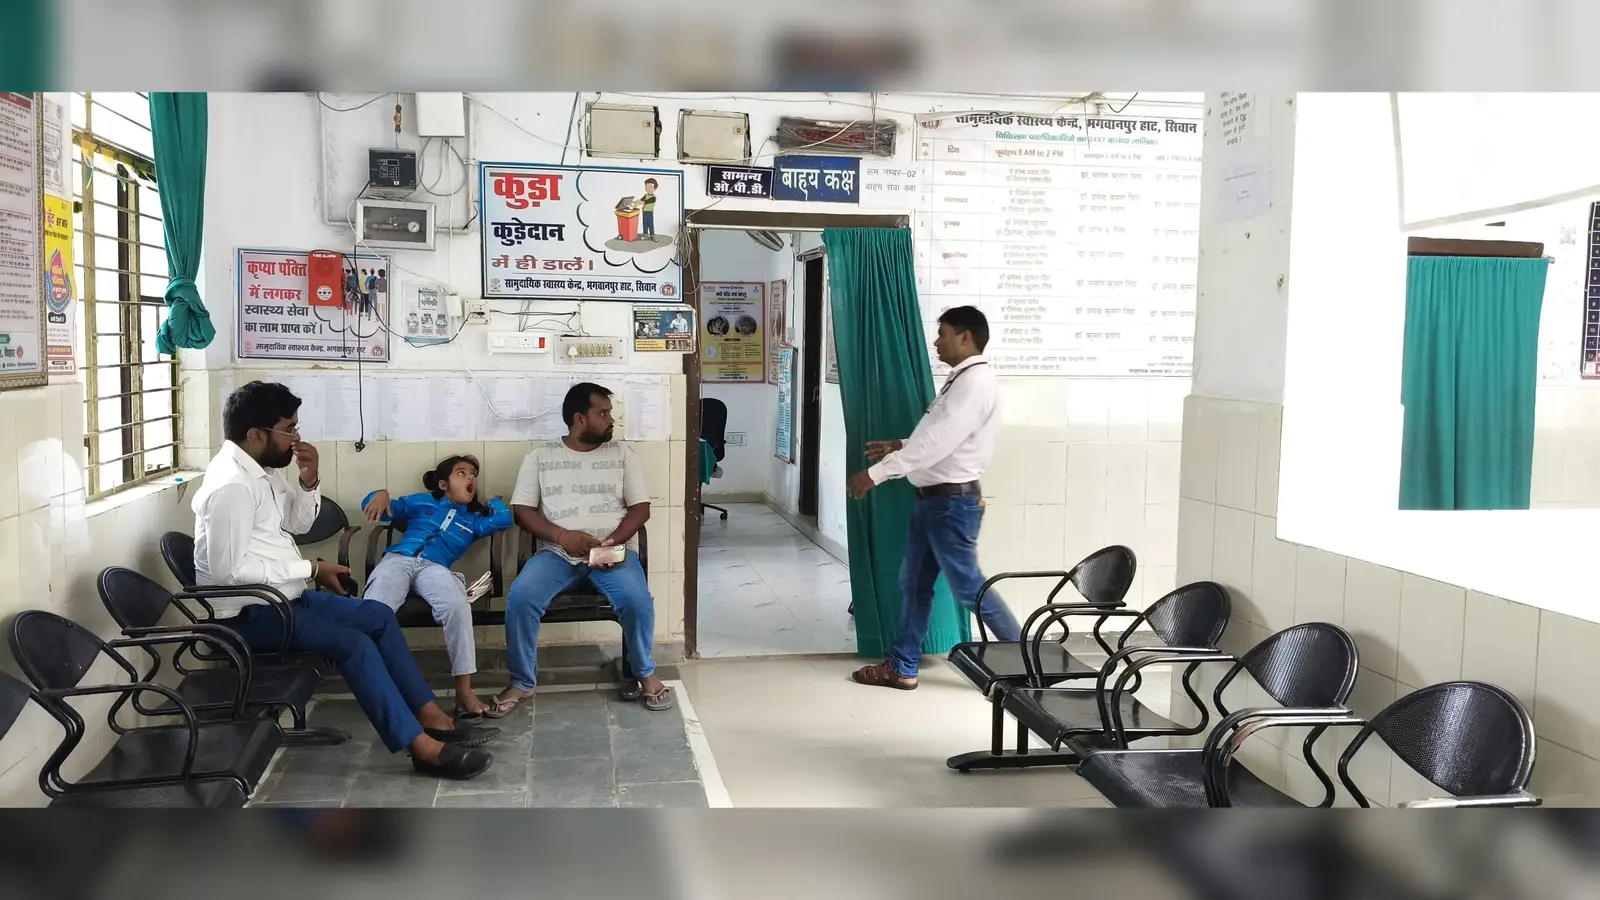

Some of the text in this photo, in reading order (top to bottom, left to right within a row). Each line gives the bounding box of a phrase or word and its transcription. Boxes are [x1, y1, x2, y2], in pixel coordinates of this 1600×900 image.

[1166, 120, 1197, 133] सिवान
[722, 171, 762, 182] सामान्य
[823, 170, 856, 195] कक्ष
[490, 172, 563, 210] कुड़ा
[714, 180, 766, 195] ओ.पी.डी.
[491, 217, 565, 246] कुड़ेदान
[492, 254, 510, 268] में
[514, 255, 538, 270] ही
[504, 278, 542, 291] सामुदायिक
[636, 280, 656, 292] सिवान
[249, 286, 302, 300] में लगकर
[245, 303, 309, 317] स्वास्थ्य सेवा
[244, 322, 257, 332] का
[280, 323, 300, 334] प्राप्त
